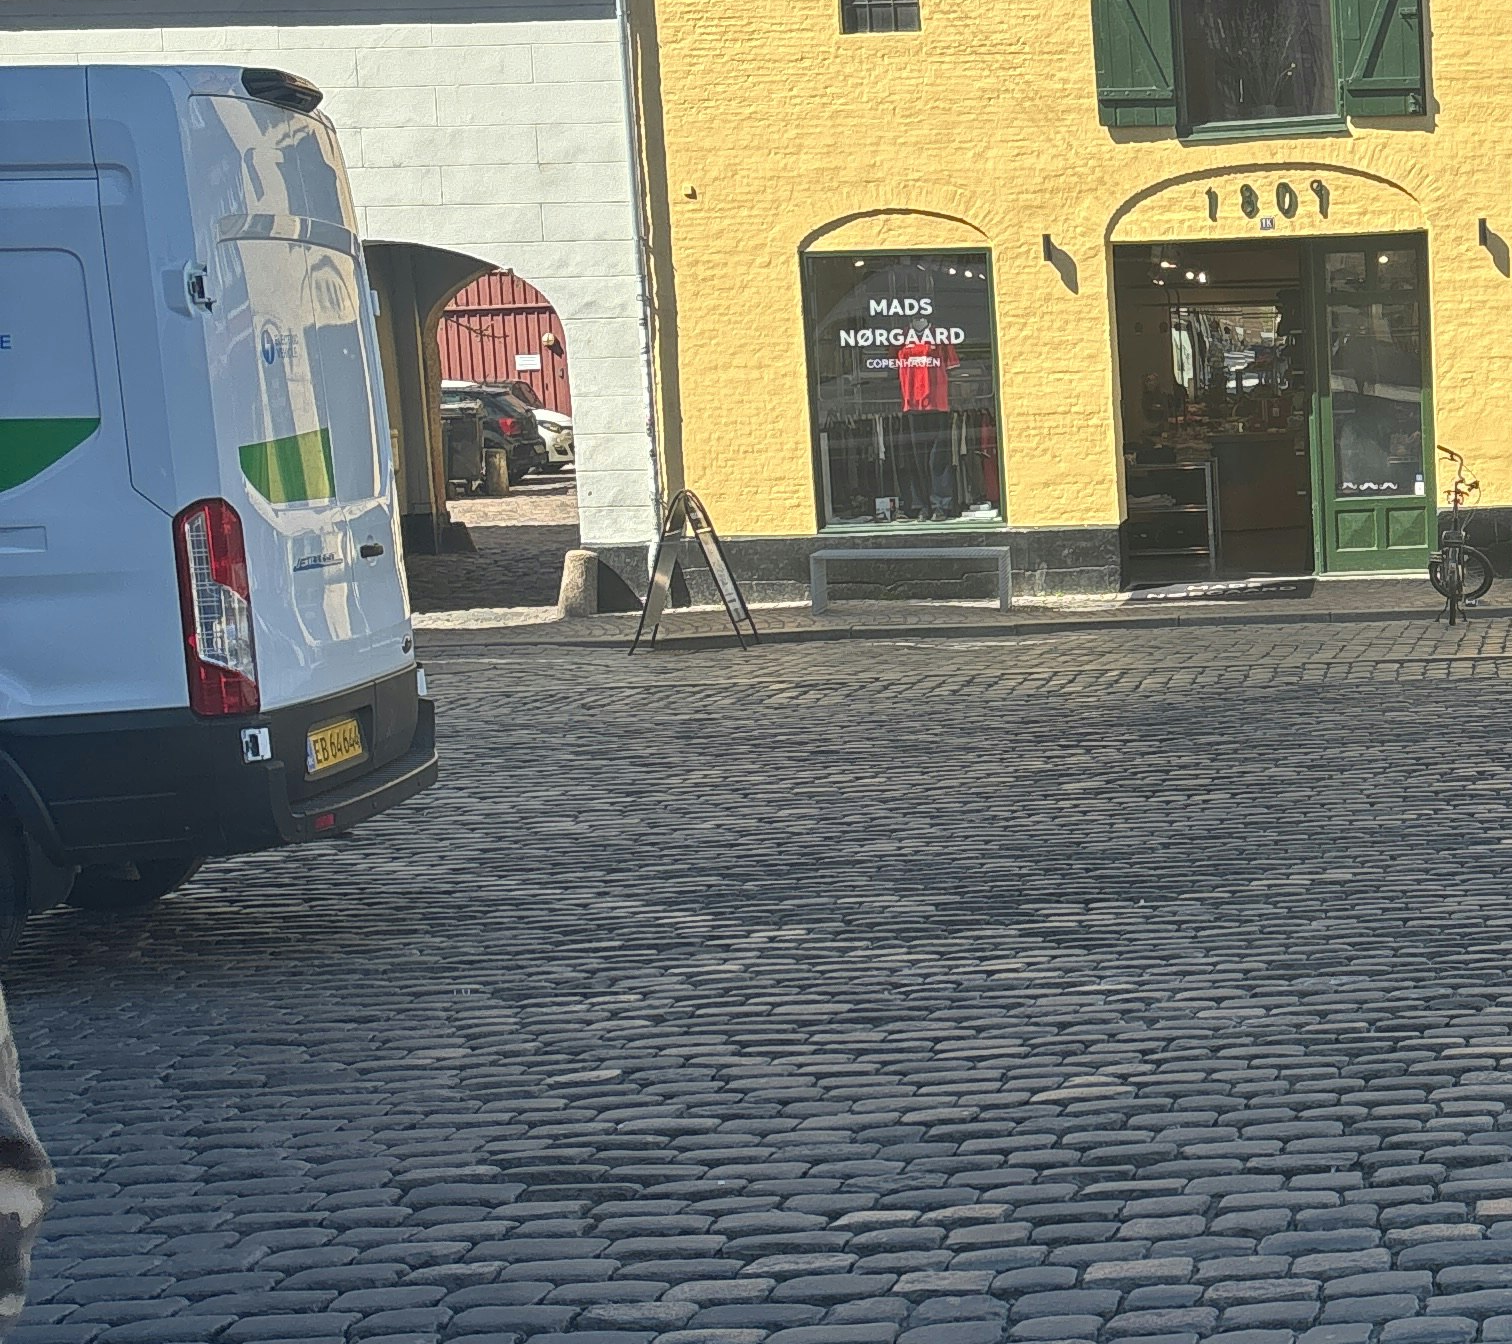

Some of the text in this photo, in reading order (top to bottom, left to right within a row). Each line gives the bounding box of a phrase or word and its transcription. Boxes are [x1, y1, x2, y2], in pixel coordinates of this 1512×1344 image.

[1204, 179, 1331, 223] 1809
[1260, 217, 1273, 229] 1K
[869, 297, 933, 316] MADS
[839, 327, 966, 347] NØRGAARD
[866, 357, 941, 369] COPENHAGEN
